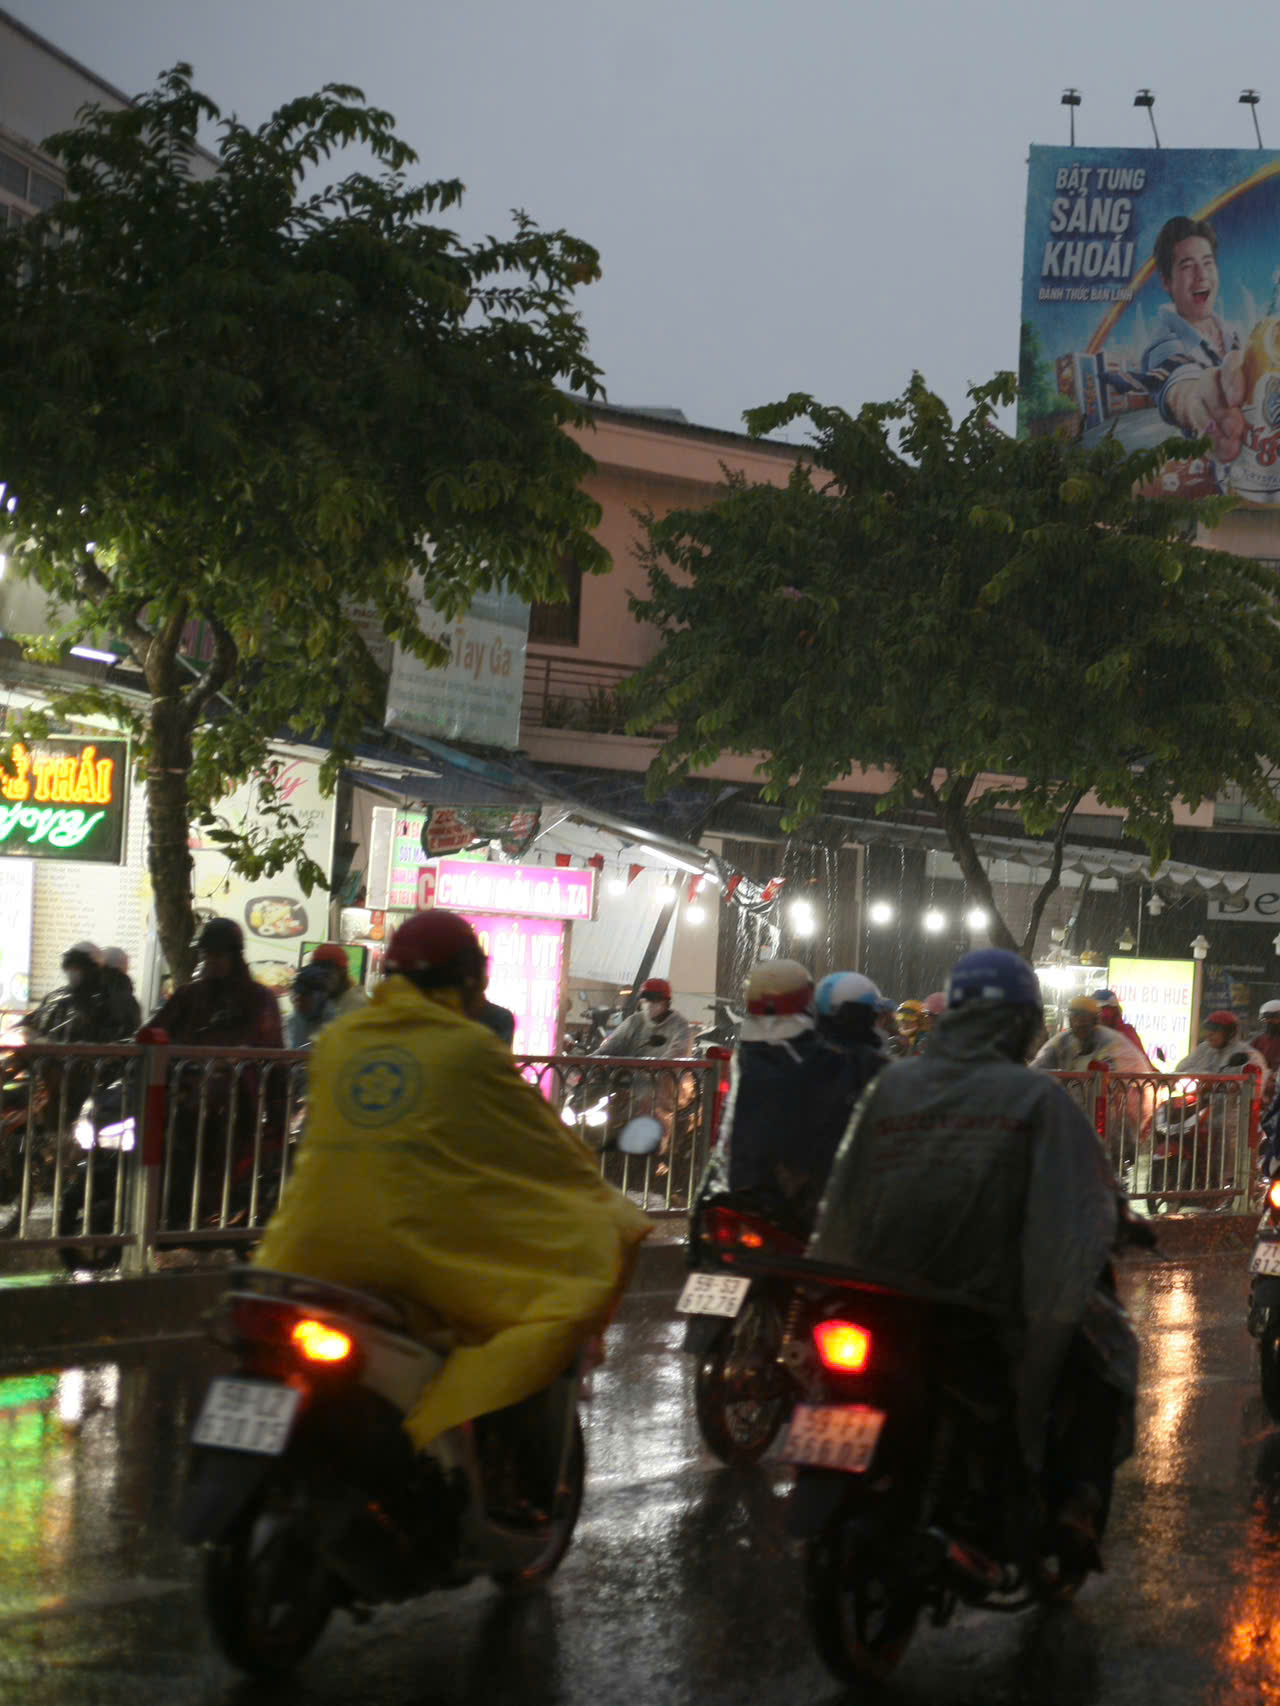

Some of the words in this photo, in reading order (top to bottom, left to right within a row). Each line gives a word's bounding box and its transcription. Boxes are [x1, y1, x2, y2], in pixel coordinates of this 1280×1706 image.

[1056, 163, 1092, 196] BẬT
[1097, 167, 1146, 191] TUNG
[1050, 188, 1131, 233] SẢNG
[1041, 234, 1135, 277] KHOÁI
[32, 745, 114, 805] THÁI
[567, 884, 589, 916] TA
